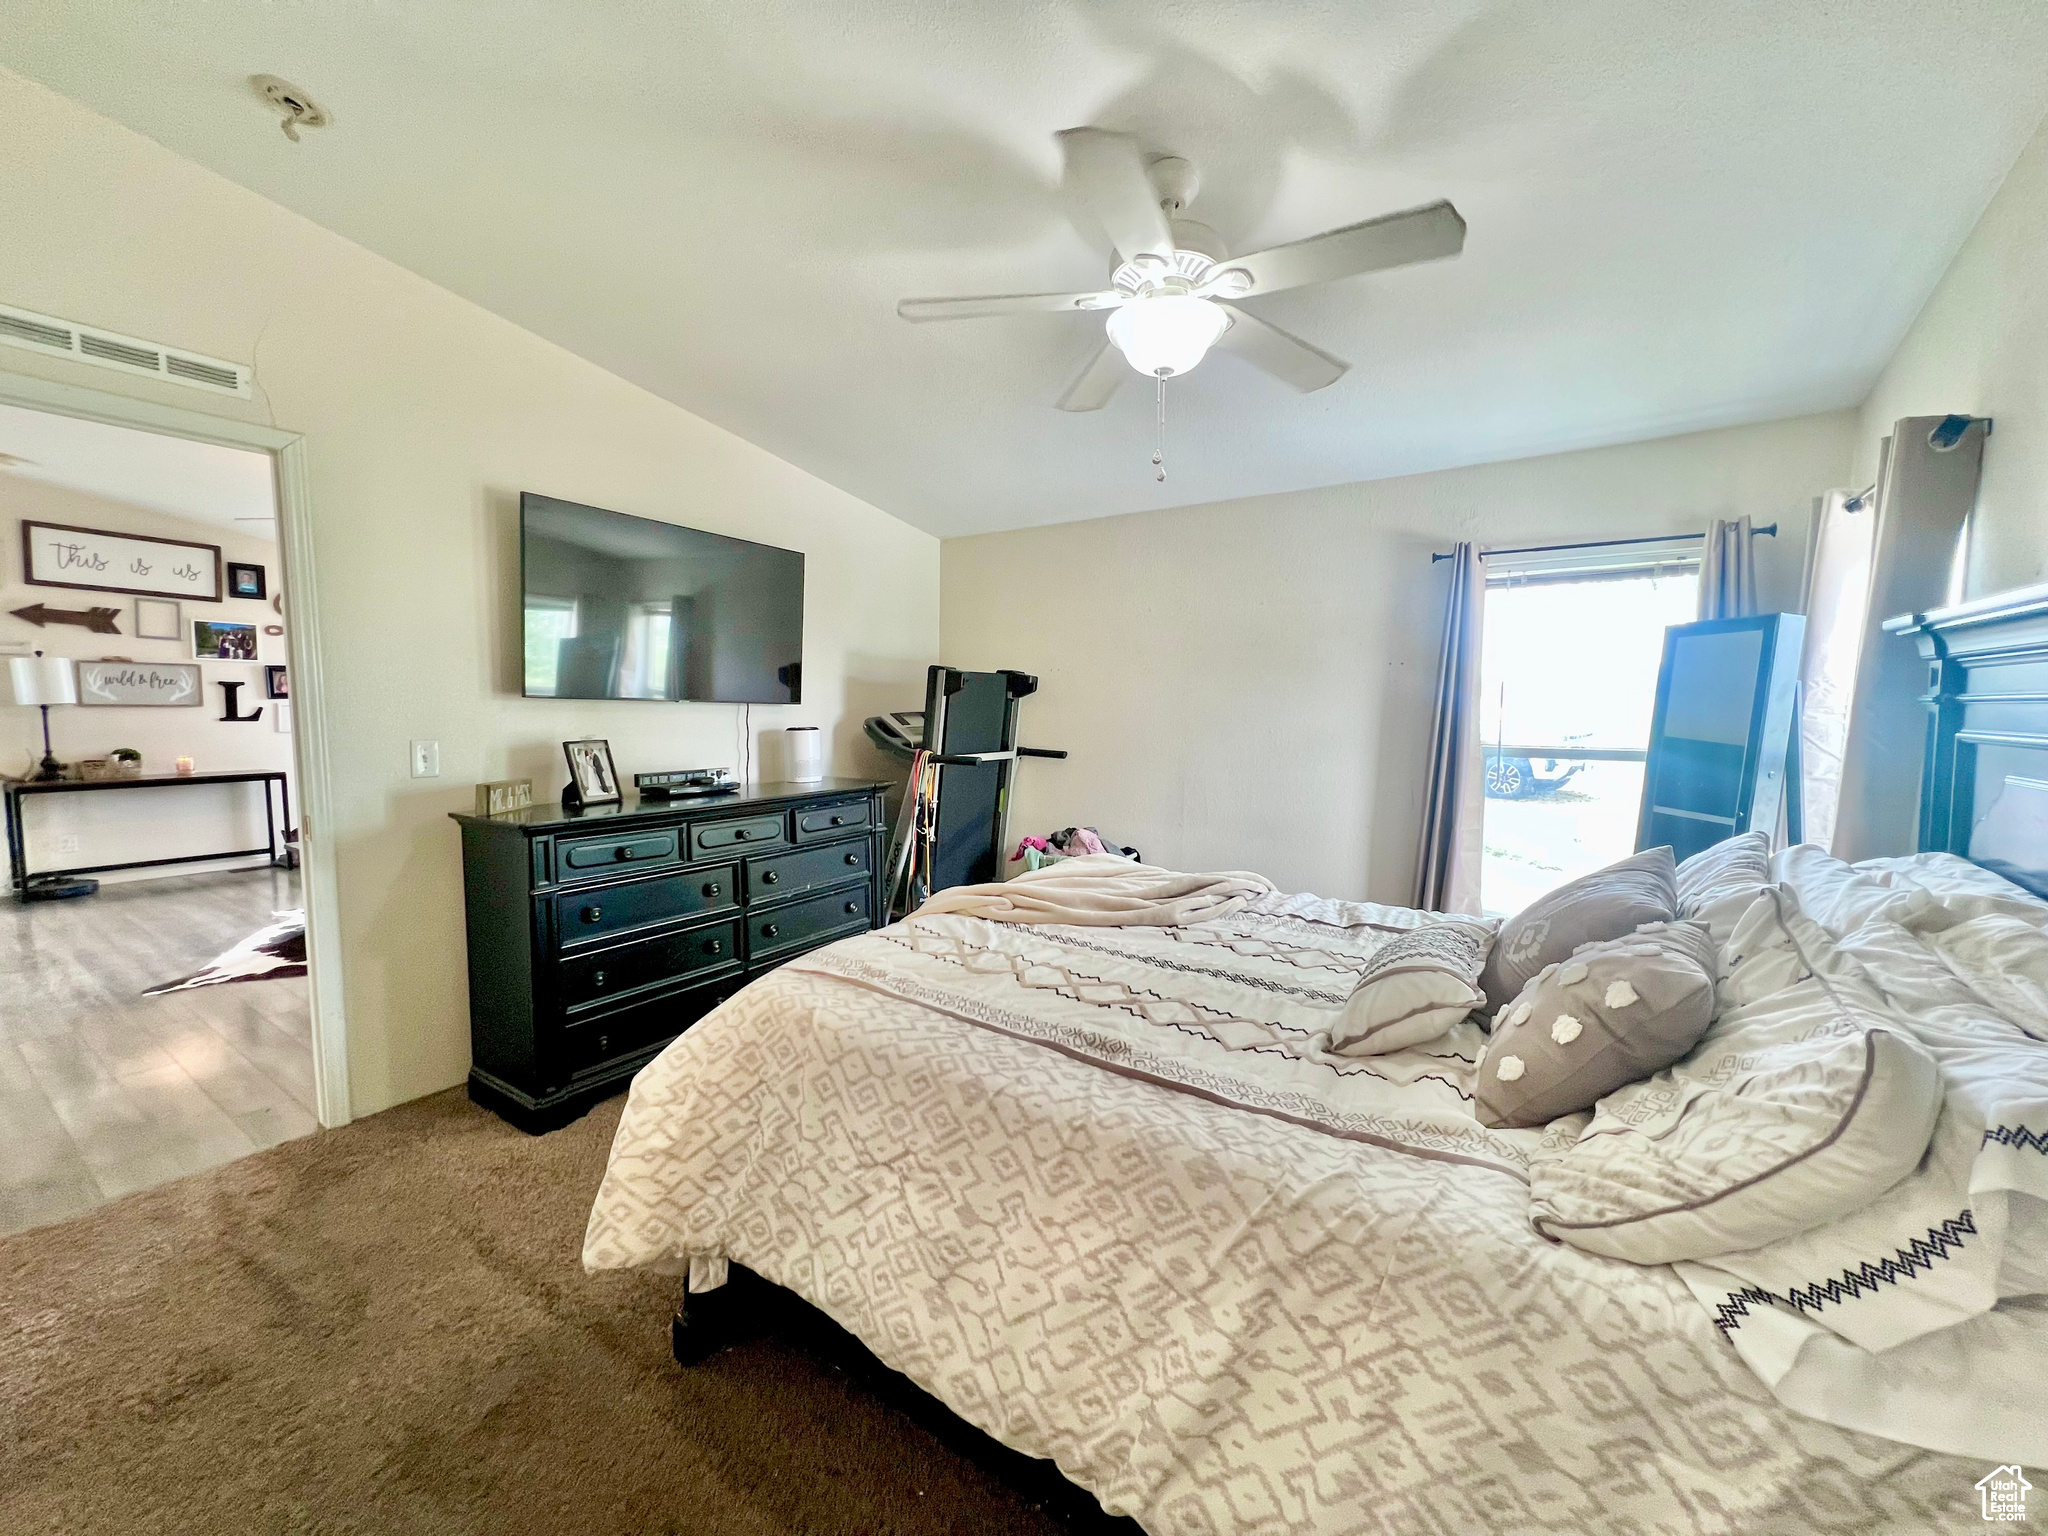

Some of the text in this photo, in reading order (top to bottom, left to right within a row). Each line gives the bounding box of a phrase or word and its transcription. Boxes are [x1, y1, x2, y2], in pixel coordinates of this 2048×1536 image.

[130, 558, 153, 576] is
[172, 563, 202, 582] us
[104, 670, 179, 690] wild & free
[217, 681, 264, 722] L
